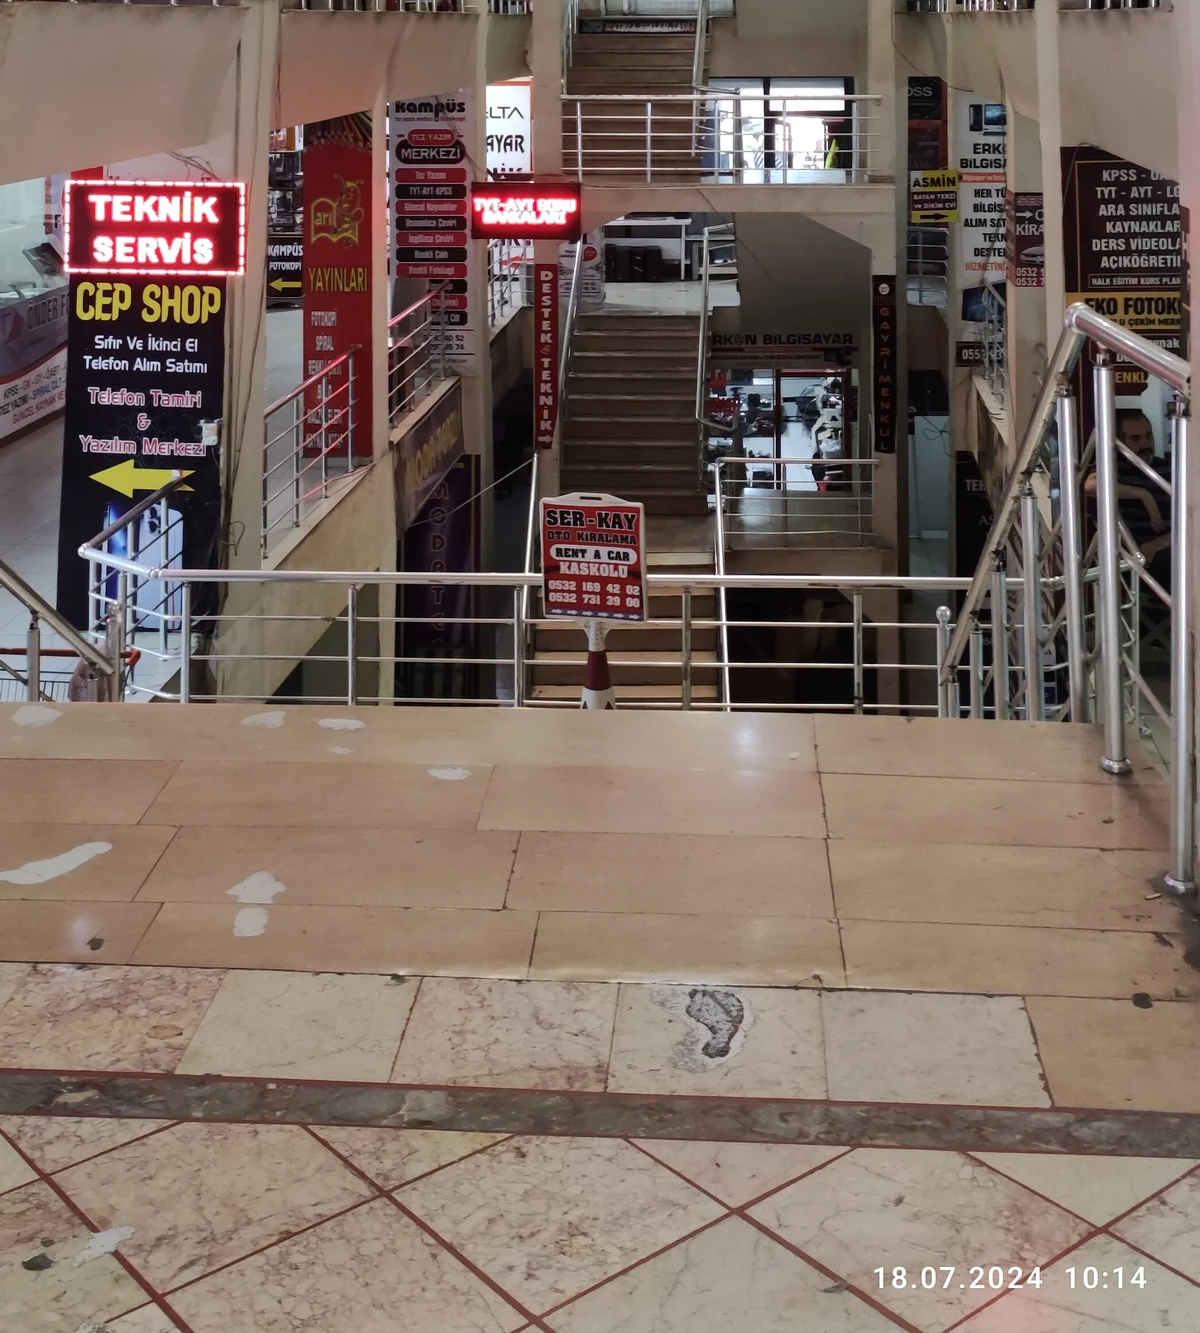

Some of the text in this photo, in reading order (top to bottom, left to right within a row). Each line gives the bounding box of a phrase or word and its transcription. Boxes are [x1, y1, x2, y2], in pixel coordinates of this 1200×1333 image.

[395, 99, 466, 122] kampüs
[401, 146, 460, 160] MERKEZİ
[1102, 169, 1137, 182] KPSS
[974, 189, 993, 199] HER
[1096, 186, 1153, 199] TYT AYT
[88, 191, 219, 223] TEKNİK
[1098, 203, 1125, 216] ARA
[964, 217, 987, 228] ALIM
[92, 232, 213, 264] SERVİS
[1092, 238, 1126, 251] DERS
[308, 267, 368, 292] YAYINLARI
[1016, 267, 1038, 277] 0532
[1016, 277, 1038, 286] 0532
[1092, 278, 1110, 286] HALK
[1140, 277, 1160, 286] KURS
[76, 281, 222, 324] CEP SHOP
[94, 334, 199, 352] Sıfır Ve İkinci El
[84, 355, 208, 374] Telefon Alım Satımı
[87, 387, 202, 409] Telefon Tamiri
[137, 413, 150, 431] &
[79, 434, 137, 455] Yazılım
[547, 530, 637, 545] OTO KİRALAMA
[555, 547, 630, 562] RENT A CAR
[559, 561, 628, 579] KASKOLU
[548, 580, 640, 596] 0532 169 42 02
[548, 592, 640, 608] 0532 731 39 00
